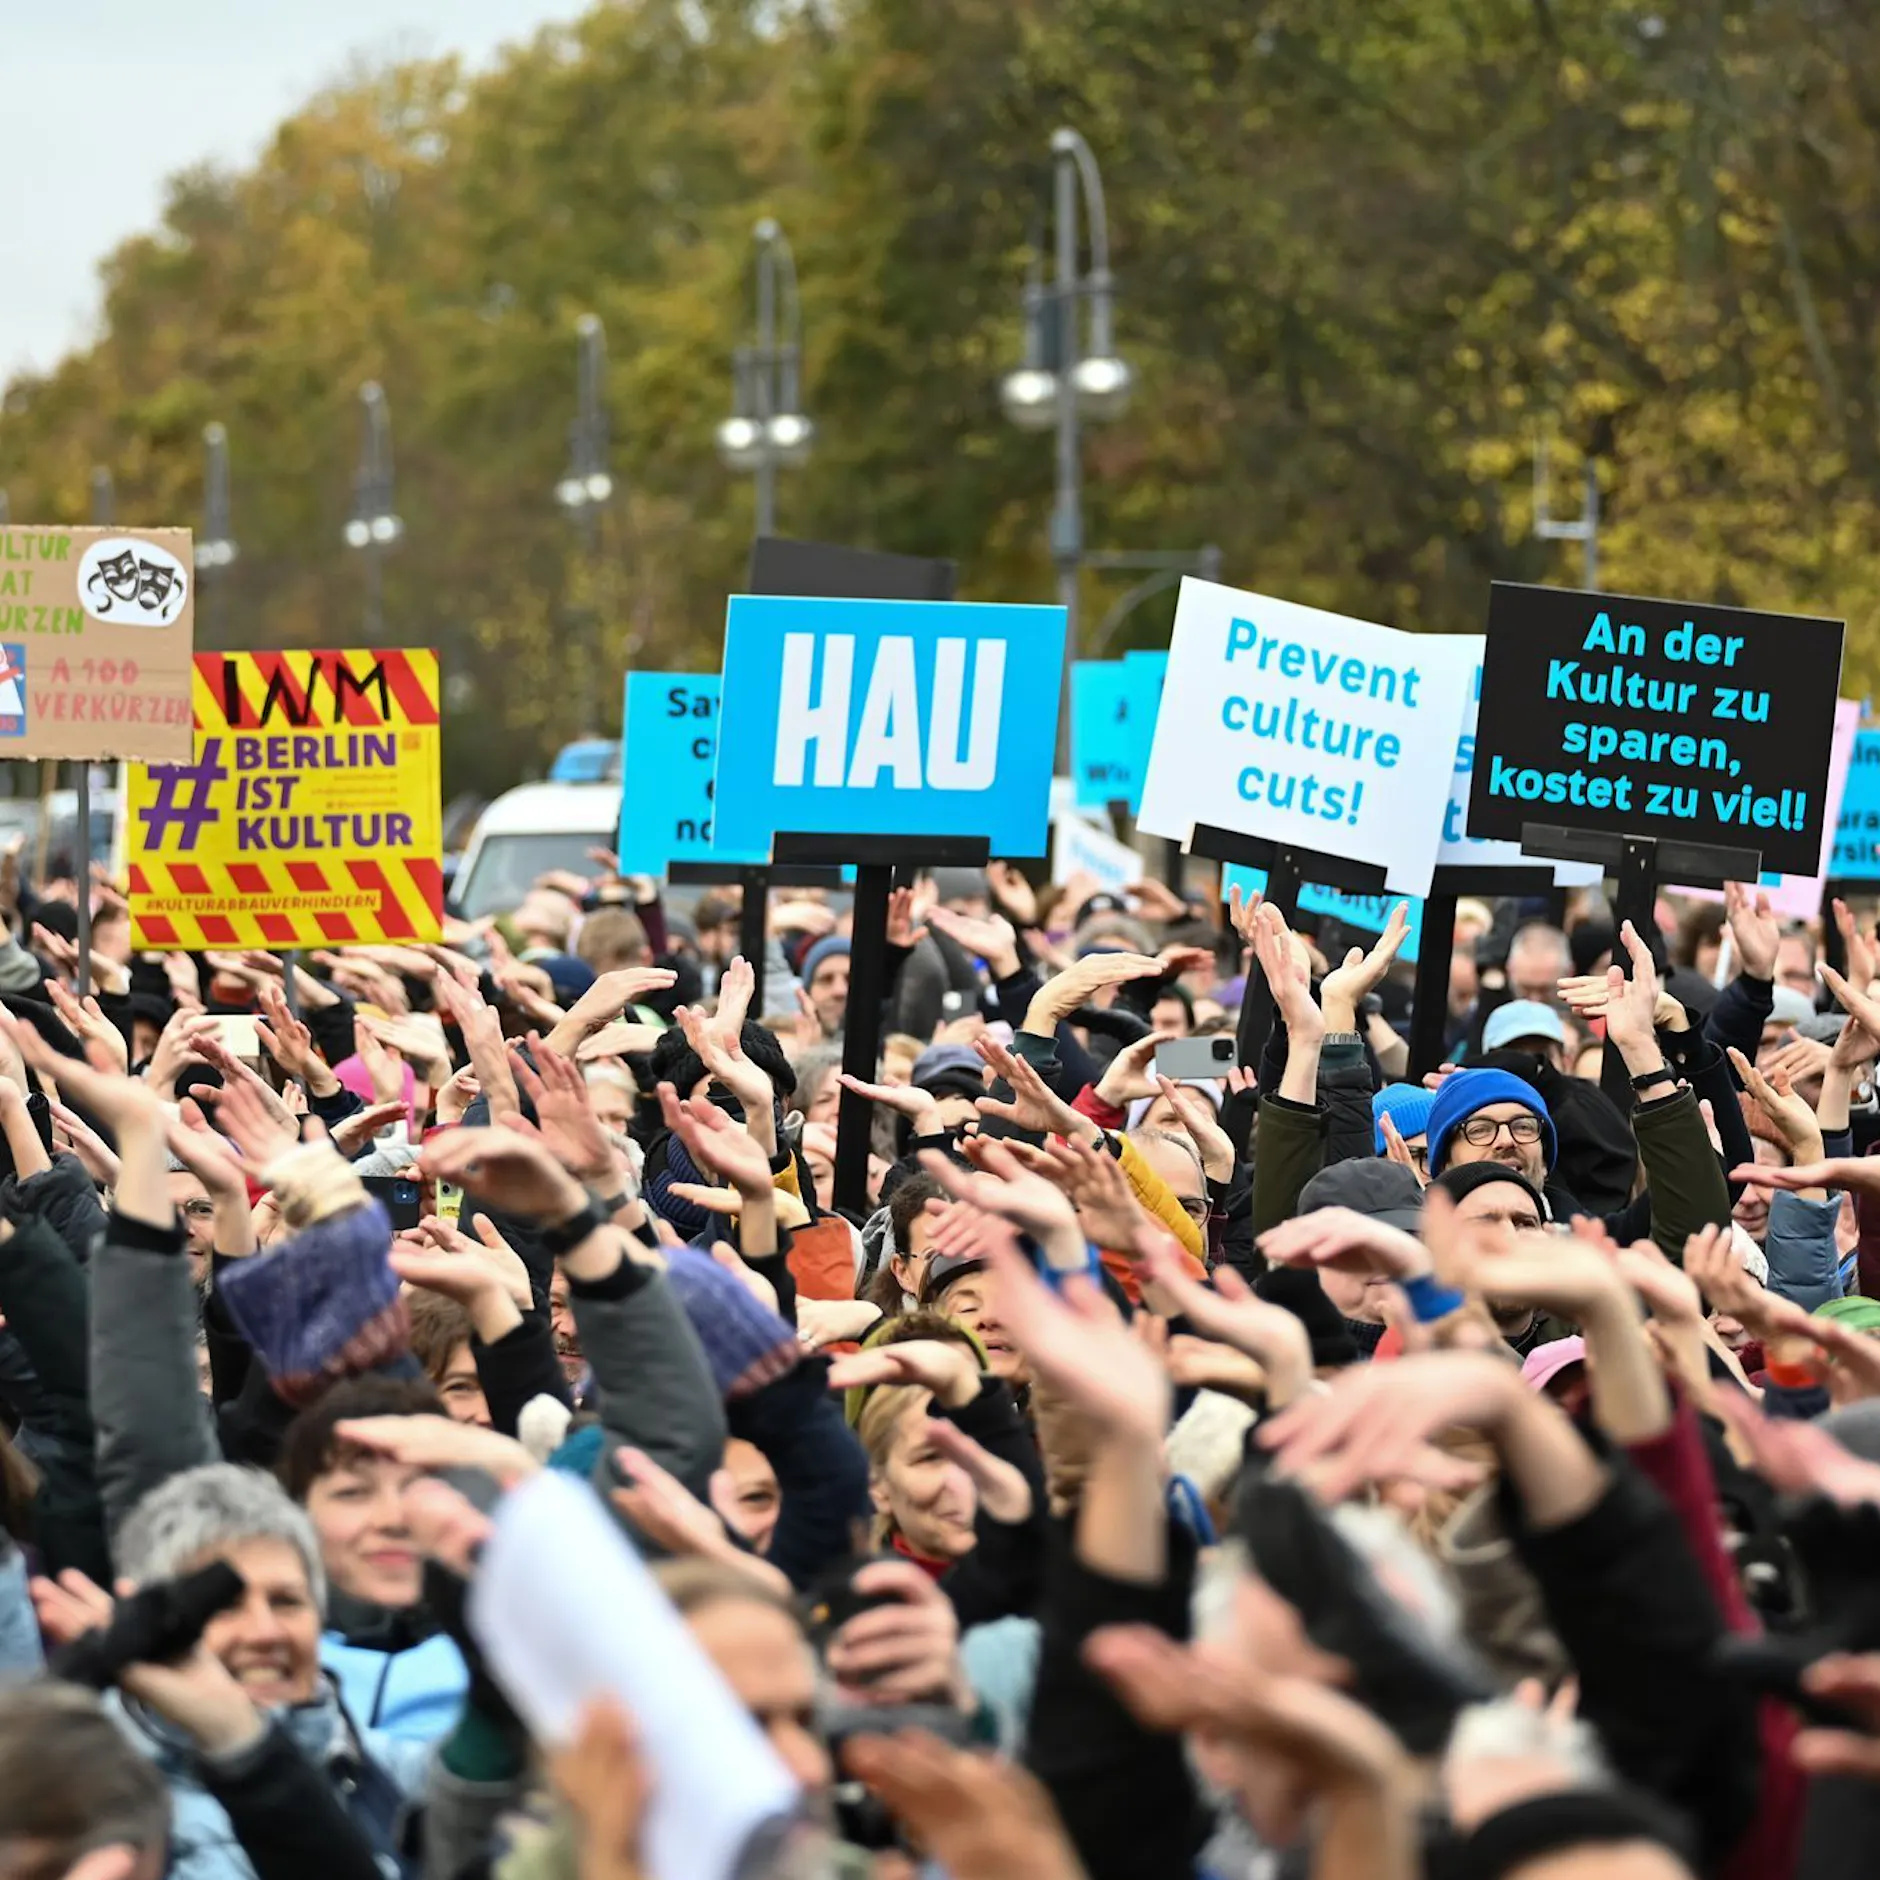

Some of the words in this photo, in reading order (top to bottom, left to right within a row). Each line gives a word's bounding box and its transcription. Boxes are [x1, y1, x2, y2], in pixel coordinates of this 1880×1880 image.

[0, 532, 71, 560] LTUR
[1225, 617, 1420, 708] Prevent
[1582, 612, 1646, 656] An
[1663, 621, 1744, 667] der
[51, 656, 70, 685] A
[82, 658, 139, 686] 100
[1546, 659, 1697, 714] Kultur
[1711, 687, 1770, 723] zu
[667, 687, 720, 718] Sa
[773, 632, 1007, 791] HAU
[236, 734, 396, 770] BERLIN
[1221, 695, 1401, 768] culture
[1561, 722, 1742, 778] sparen,
[235, 776, 300, 811] IST
[1237, 766, 1363, 825] cuts!
[1488, 755, 1633, 811] kostet
[1644, 784, 1699, 819] zu
[1712, 784, 1807, 831] viel!
[238, 813, 413, 850] KULTUR
[146, 895, 377, 912] #KULTURABBAUVERHINDERN
